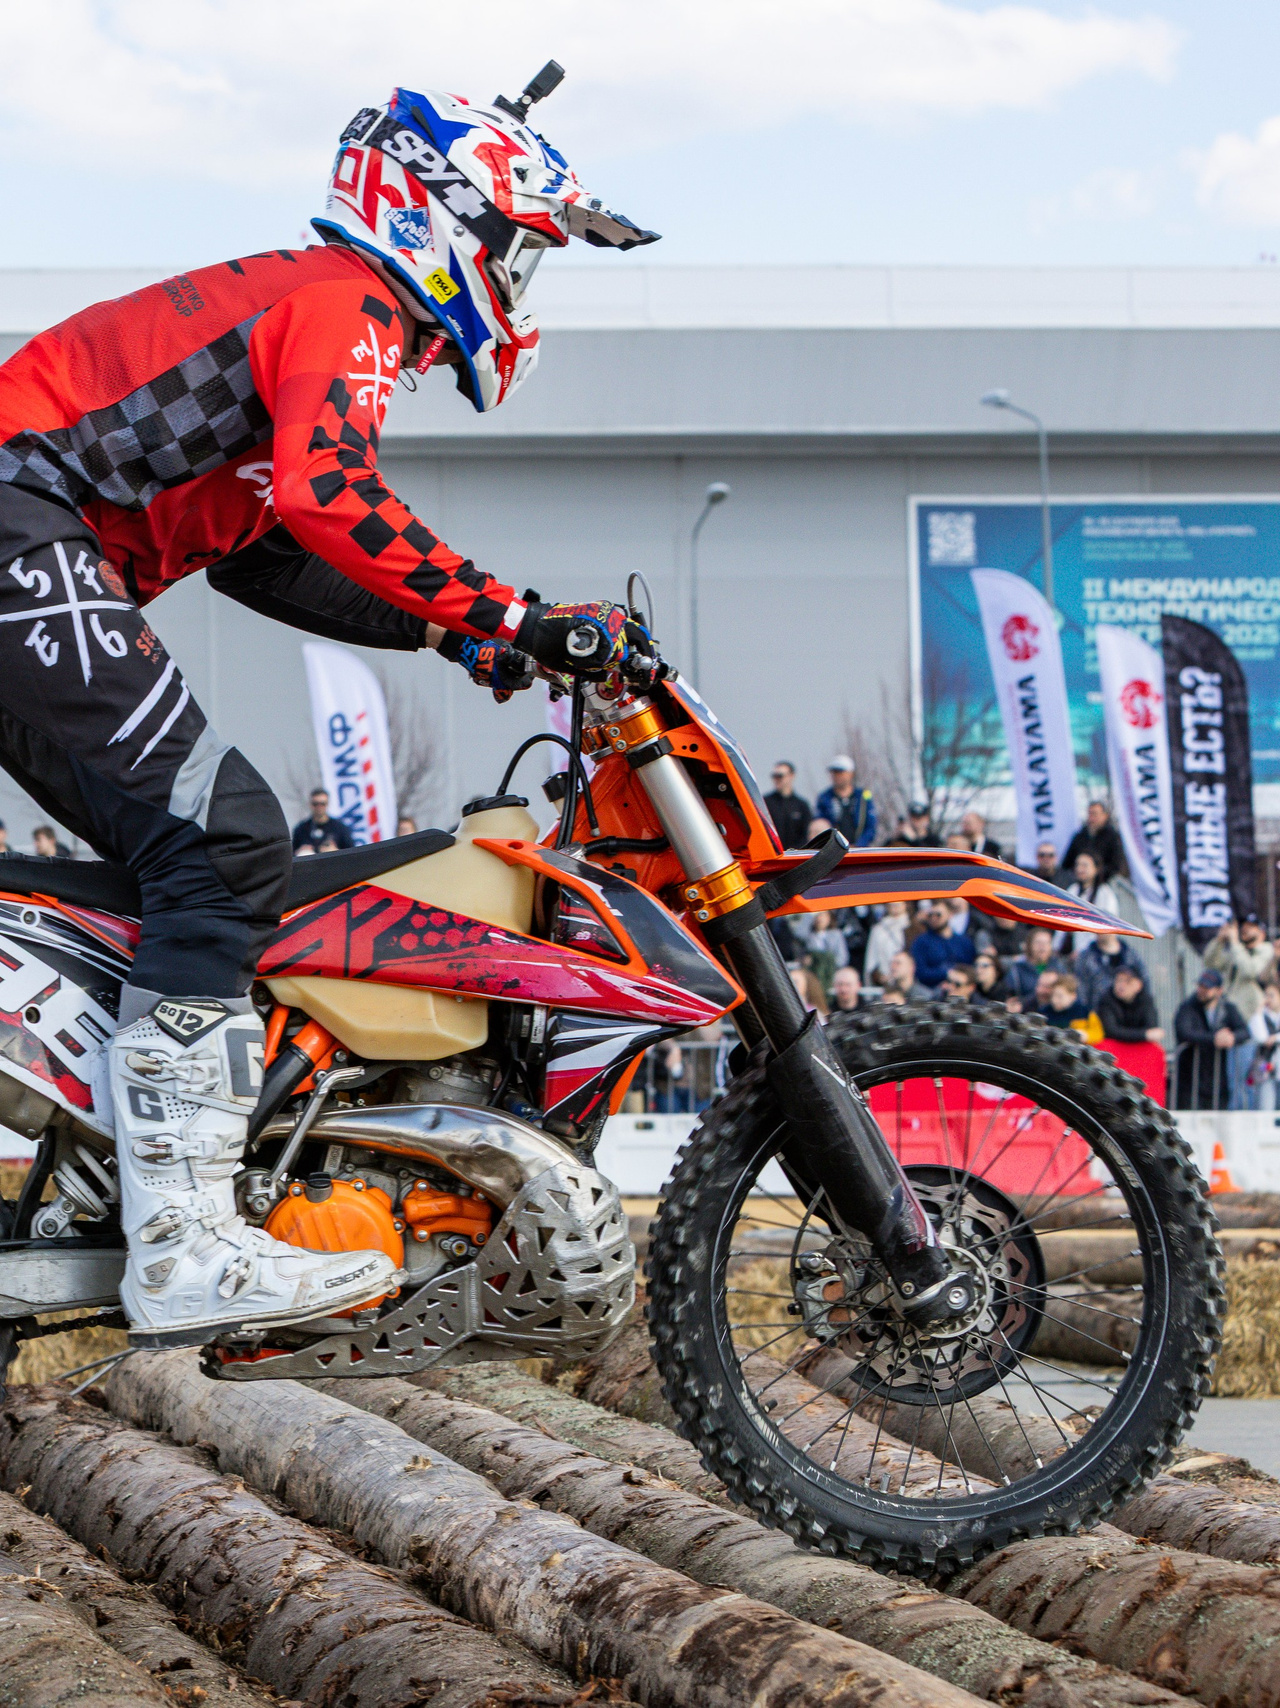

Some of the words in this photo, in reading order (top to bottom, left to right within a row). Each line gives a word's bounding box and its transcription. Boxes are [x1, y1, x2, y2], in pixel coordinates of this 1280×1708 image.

[381, 130, 466, 181] SPY
[161, 281, 193, 317] GROUP
[503, 364, 512, 388] AIROH
[1179, 666, 1226, 774] ЕСТЬ?
[1017, 674, 1054, 836] TAKAYAMA
[173, 1008, 204, 1033] 12
[324, 1259, 380, 1289] GAERNE
